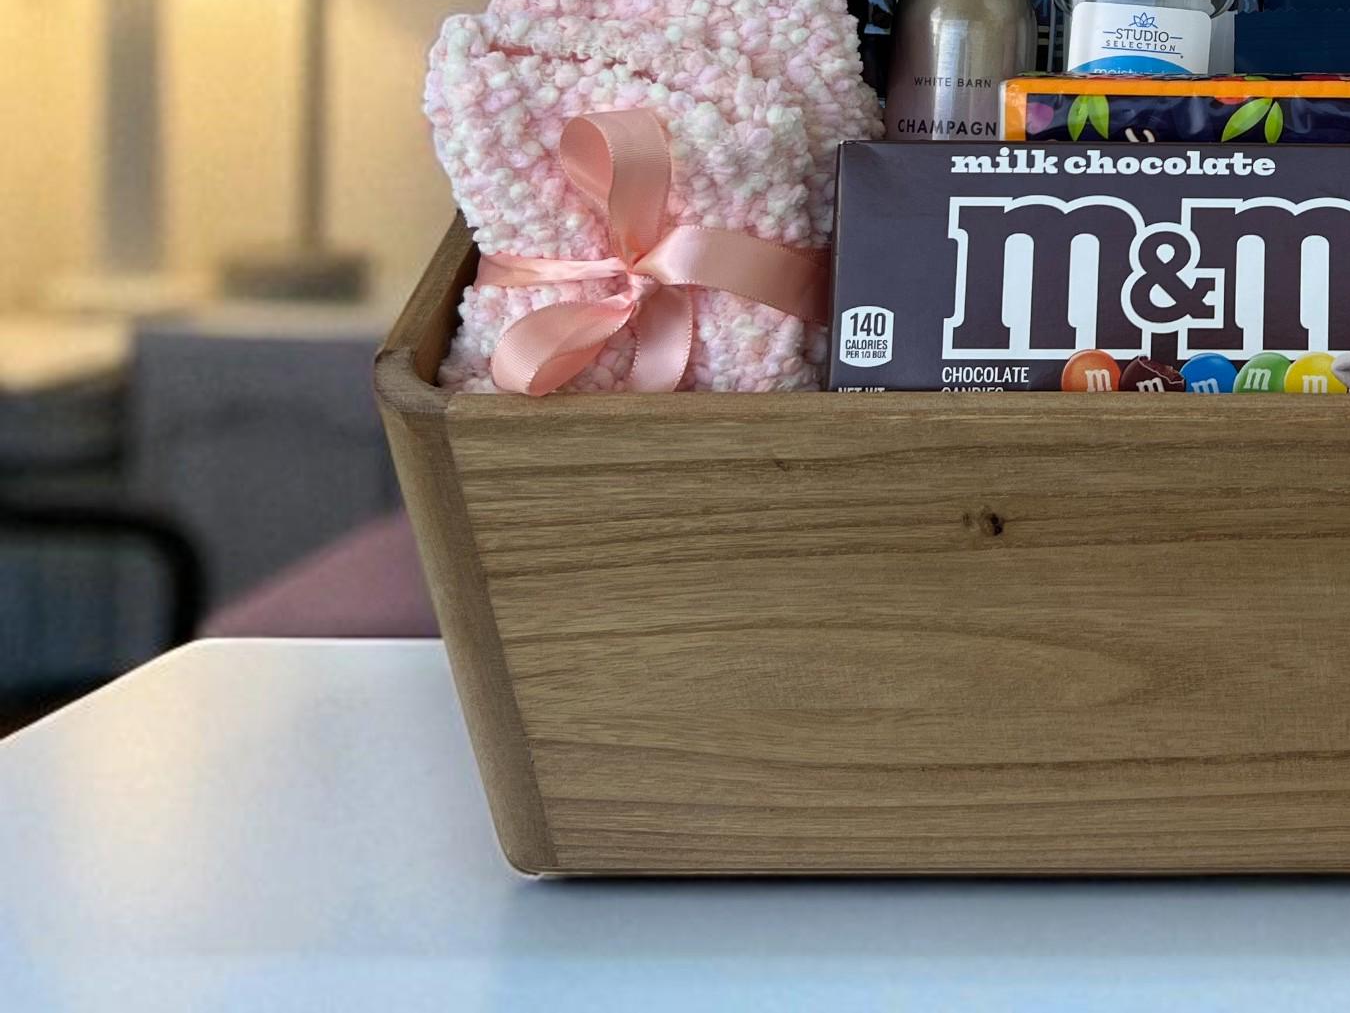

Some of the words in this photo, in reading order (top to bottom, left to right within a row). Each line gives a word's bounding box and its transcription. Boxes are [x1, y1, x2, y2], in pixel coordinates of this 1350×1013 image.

[1115, 28, 1169, 43] STUDIO
[1106, 39, 1177, 52] SELECTION
[914, 76, 951, 87] WHITE
[957, 77, 992, 88] BARN
[898, 118, 997, 136] CHAMPAGN
[951, 146, 1058, 174] milk
[1064, 149, 1276, 176] chocolate
[850, 312, 886, 337] 140
[845, 339, 888, 350] CALORIES
[845, 350, 859, 359] PER
[861, 350, 871, 359] 1/3
[872, 351, 887, 359] BOX
[941, 366, 1029, 383] CHOCOLATE
[1085, 368, 1112, 392] m
[1243, 368, 1271, 390] m
